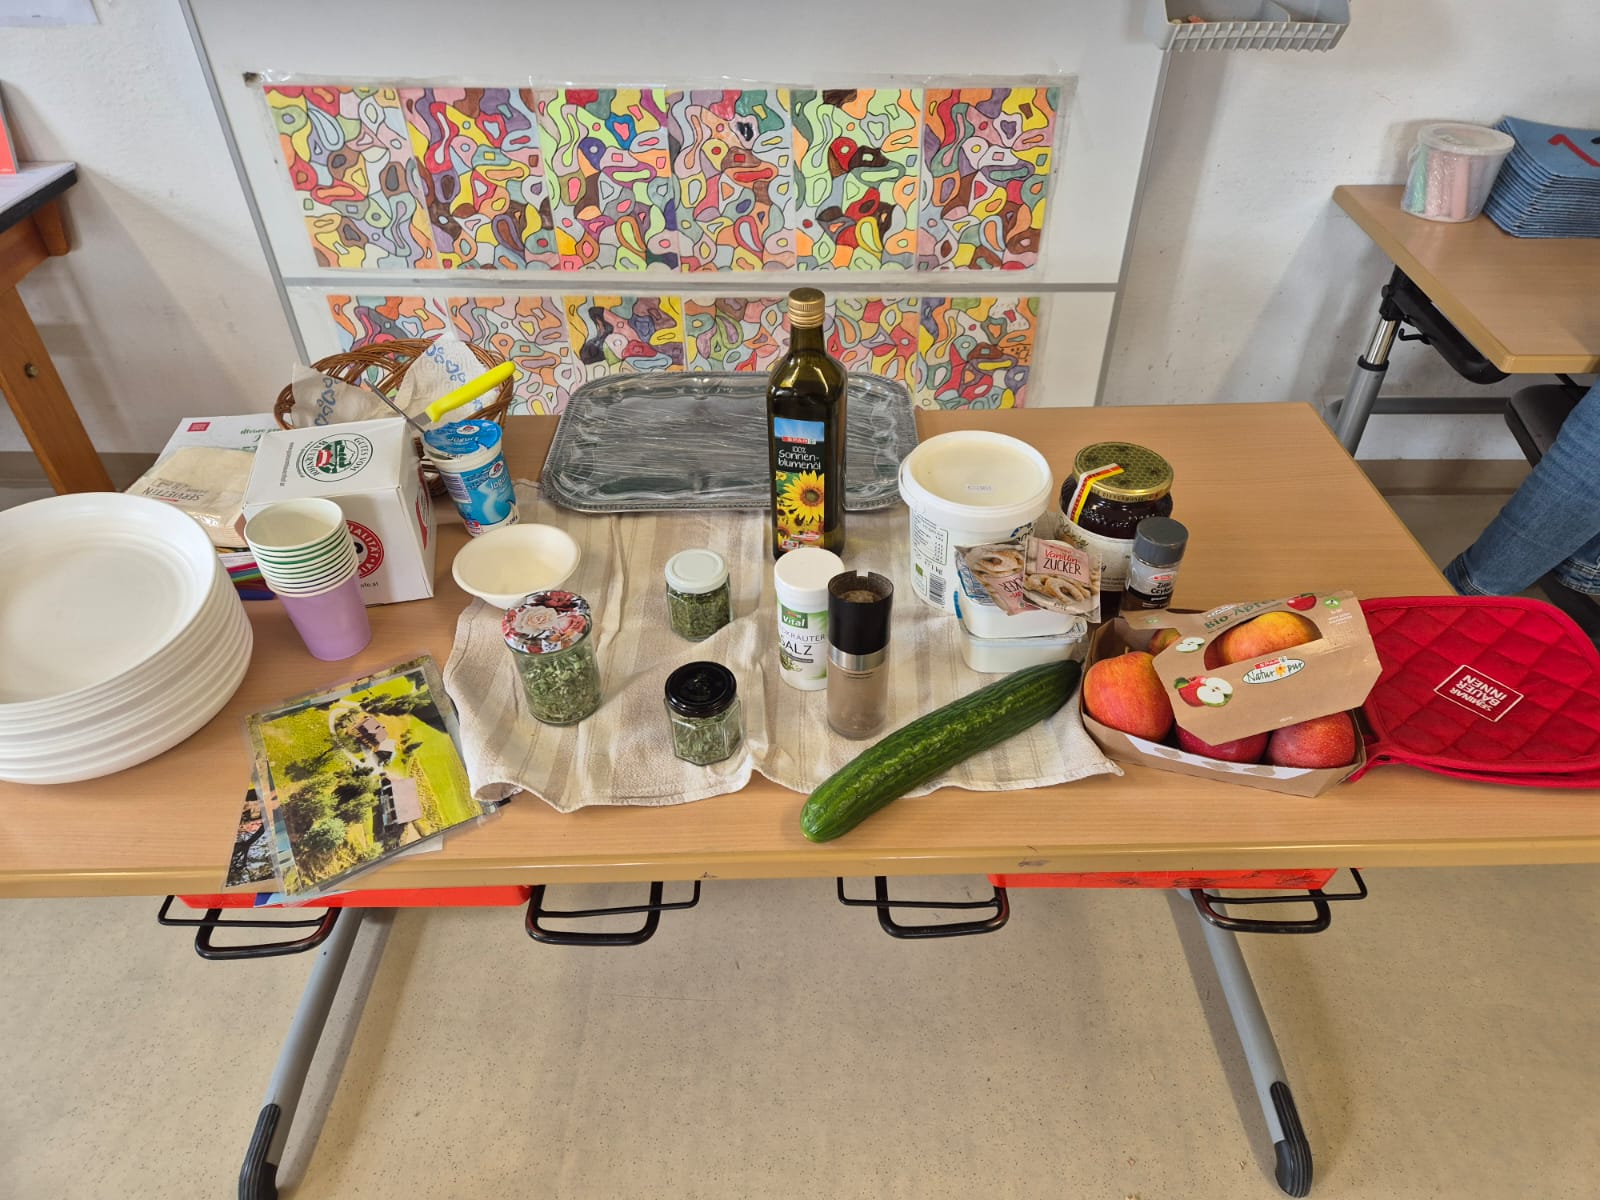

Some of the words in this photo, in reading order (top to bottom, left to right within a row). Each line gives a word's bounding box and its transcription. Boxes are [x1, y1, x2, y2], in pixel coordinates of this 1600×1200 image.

[778, 450, 820, 461] Sonnen-
[778, 458, 821, 470] blumenöl
[1043, 558, 1082, 576] ZUCKER
[1247, 669, 1276, 683] Natur
[1287, 662, 1303, 674] pur
[1461, 674, 1508, 701] INNEN
[1449, 687, 1493, 712] SEMINAR
